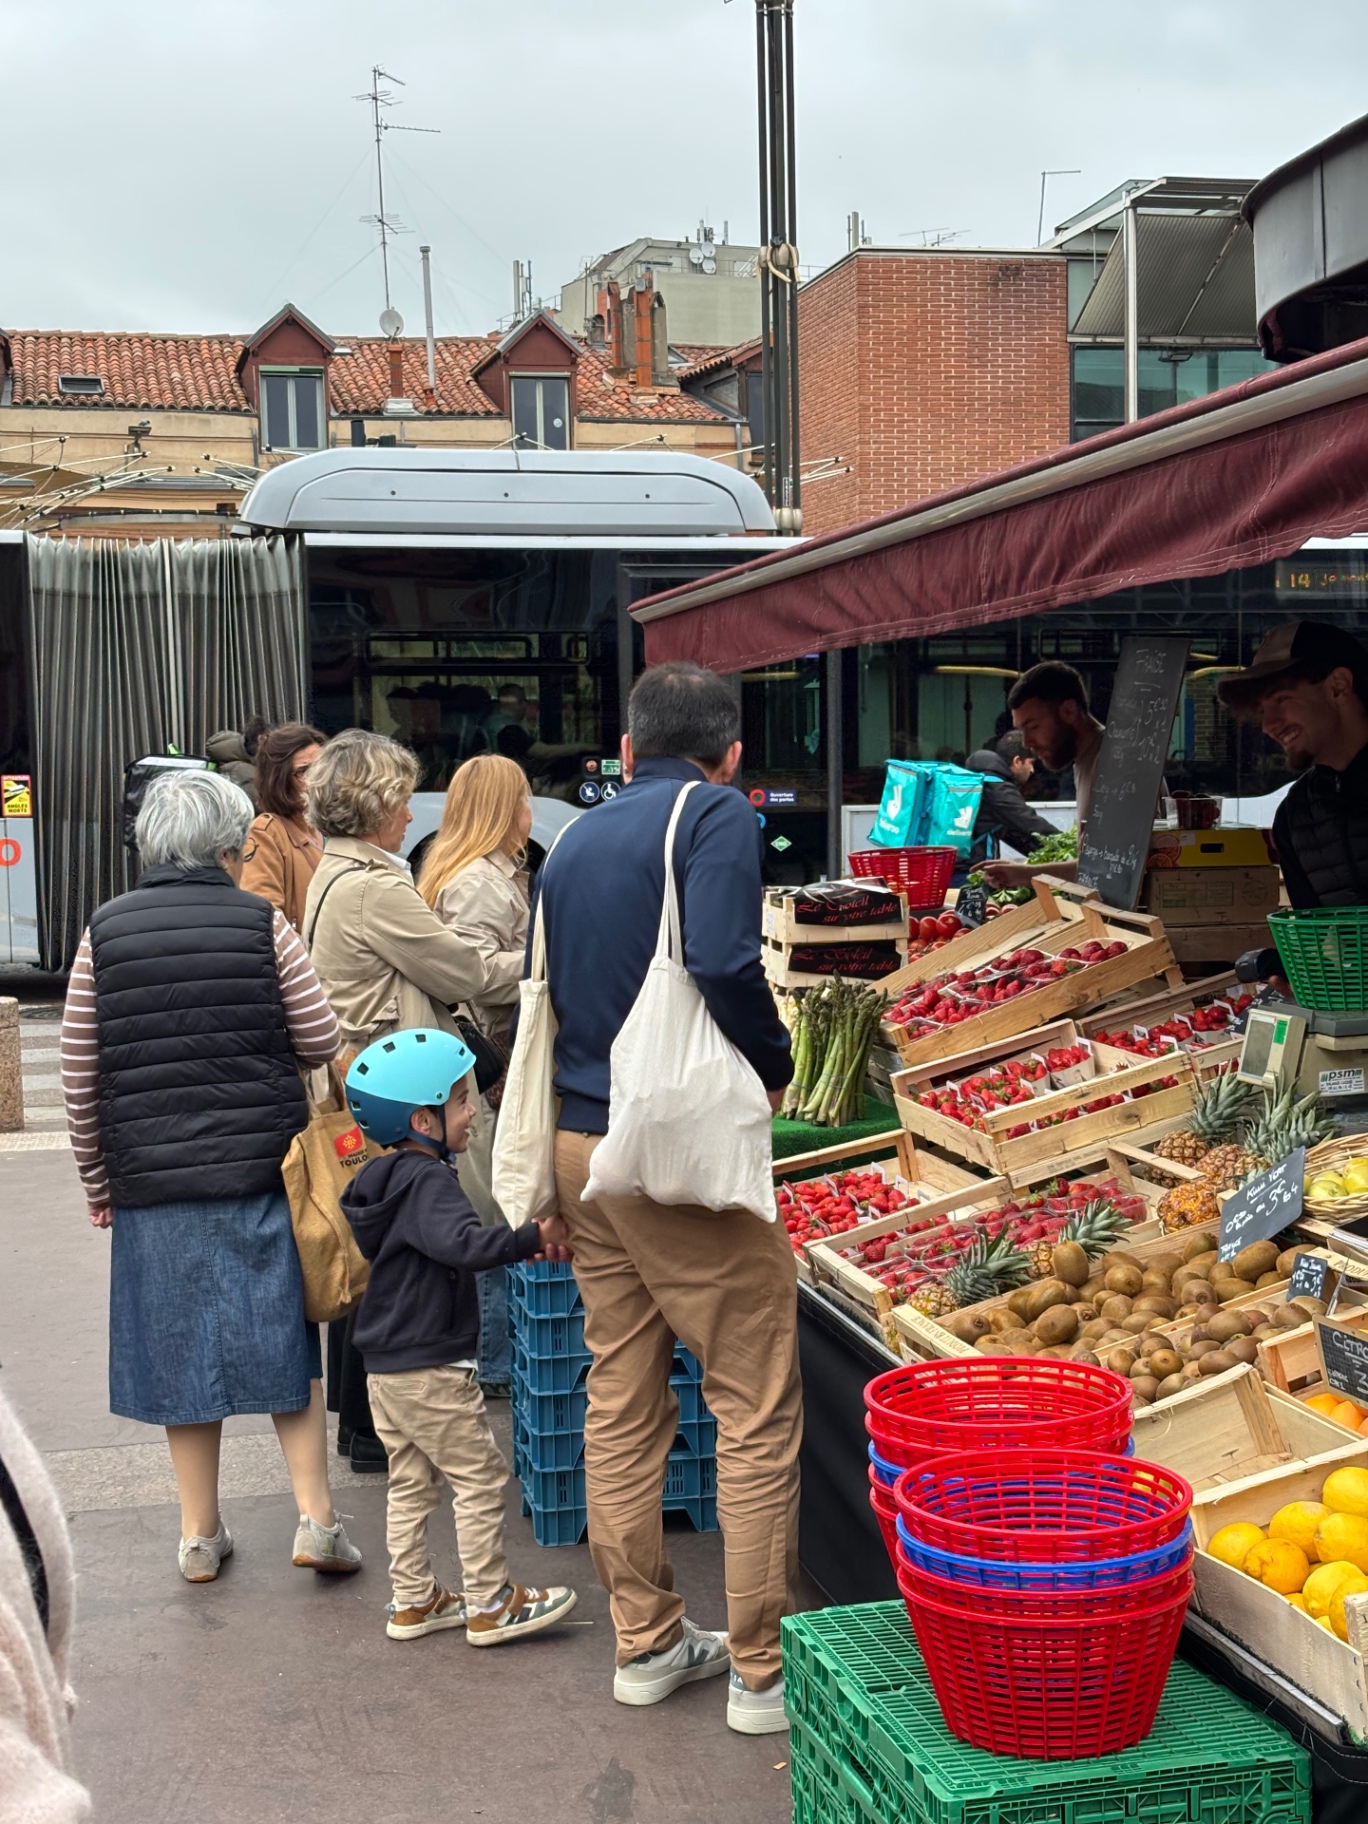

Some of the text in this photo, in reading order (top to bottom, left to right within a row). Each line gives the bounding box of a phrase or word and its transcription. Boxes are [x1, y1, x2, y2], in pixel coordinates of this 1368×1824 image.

[1290, 573, 1311, 588] 14
[796, 900, 822, 913] Le
[823, 902, 899, 923] sur votre table
[791, 947, 874, 960] Le Soleil
[816, 960, 899, 972] sur votre table
[1328, 1069, 1355, 1082] psm
[339, 1154, 368, 1168] TOULO
